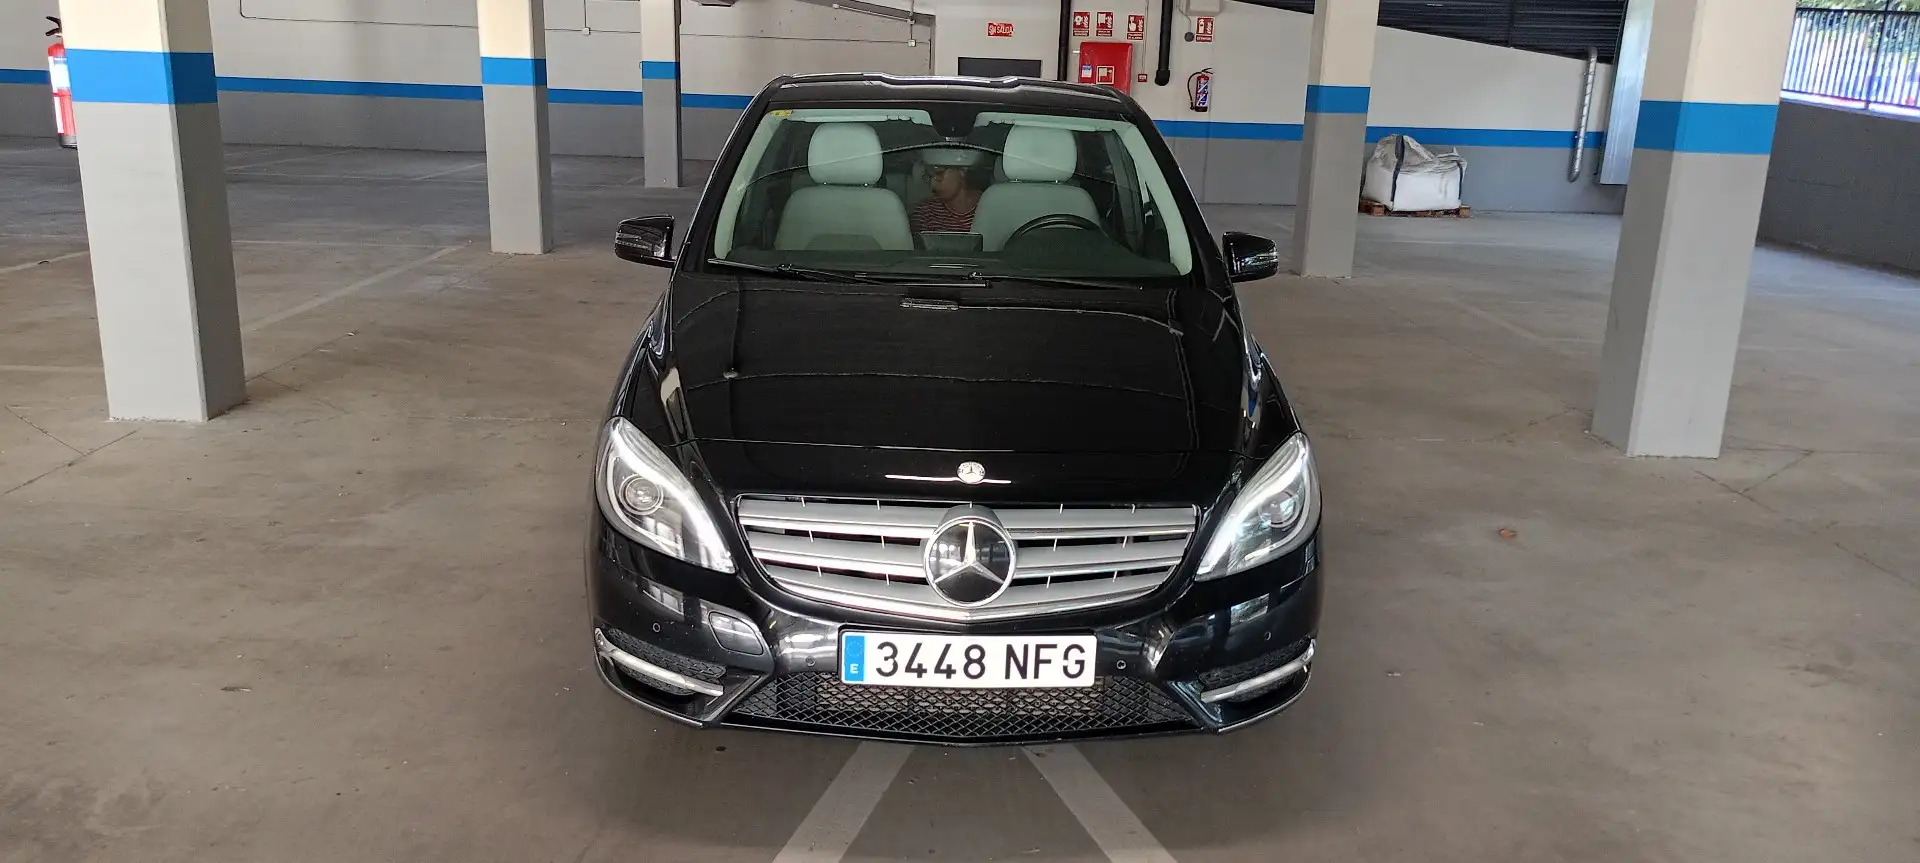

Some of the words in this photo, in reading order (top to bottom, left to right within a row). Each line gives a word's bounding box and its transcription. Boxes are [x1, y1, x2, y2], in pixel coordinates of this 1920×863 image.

[849, 663, 859, 674] E
[875, 641, 986, 679] 3448
[1004, 643, 1086, 680] NFG
